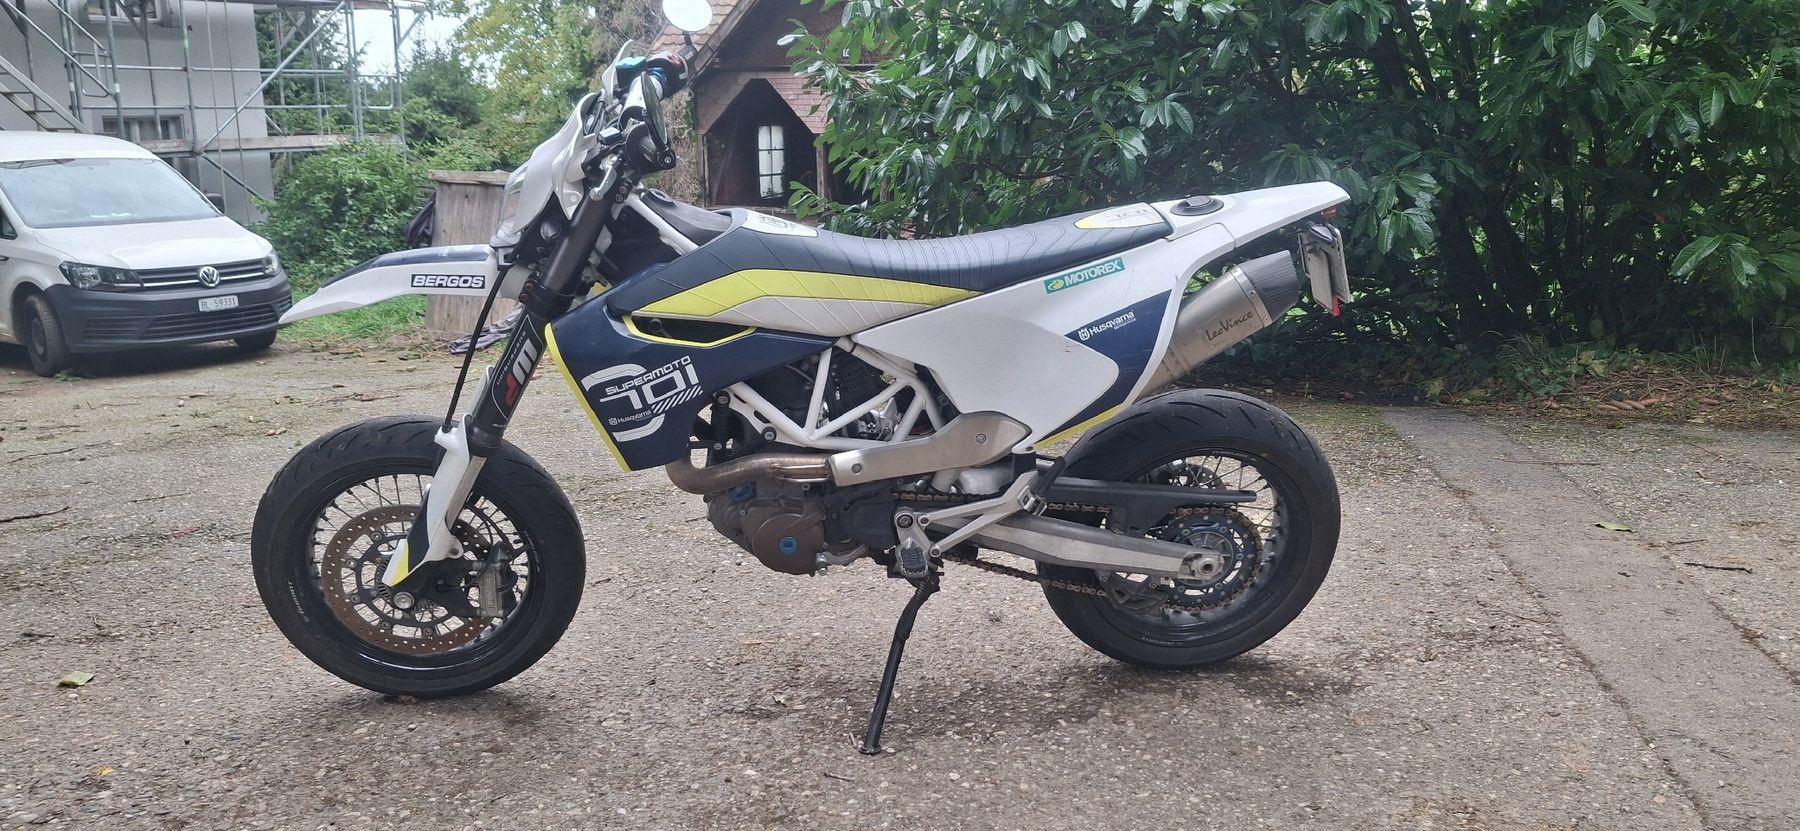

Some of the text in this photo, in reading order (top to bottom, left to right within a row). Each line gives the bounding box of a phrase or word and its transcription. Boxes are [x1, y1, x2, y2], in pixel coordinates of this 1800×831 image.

[412, 275, 484, 288] BERGOS
[1064, 260, 1122, 287] MOTOREX
[1089, 311, 1135, 336] Husqvarna
[1205, 311, 1253, 341] LeoVince
[600, 363, 699, 410] 701
[605, 355, 691, 396] SUPERMOTO
[617, 409, 652, 424] Husqvarna
